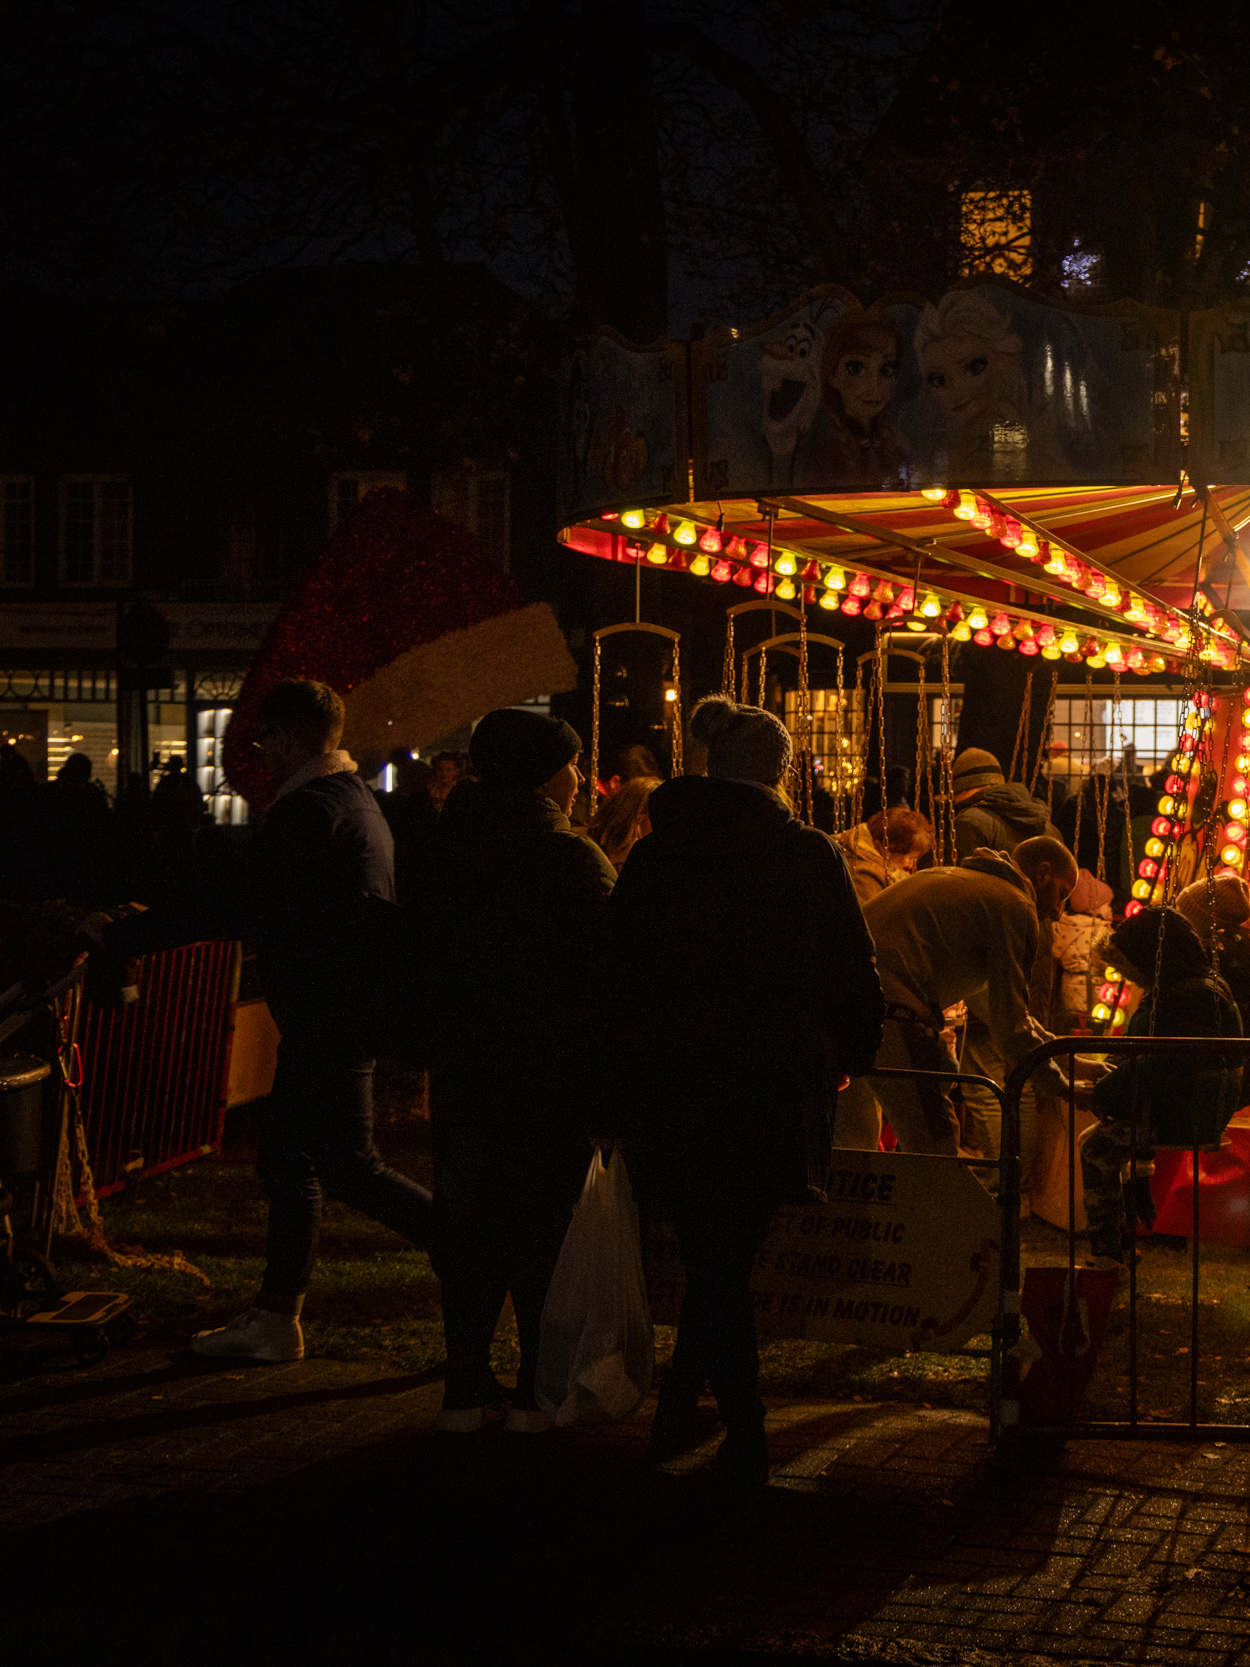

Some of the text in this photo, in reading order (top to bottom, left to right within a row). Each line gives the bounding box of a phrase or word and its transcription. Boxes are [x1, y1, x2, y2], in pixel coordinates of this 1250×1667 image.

[828, 1171, 896, 1201] TICE
[800, 1216, 828, 1235] OF
[831, 1218, 905, 1244] PUBLIC
[775, 1252, 841, 1276] STAND
[846, 1258, 912, 1286] CLEAR
[779, 1292, 801, 1314] IS
[804, 1295, 830, 1317] IN
[832, 1299, 921, 1328] MOTION
